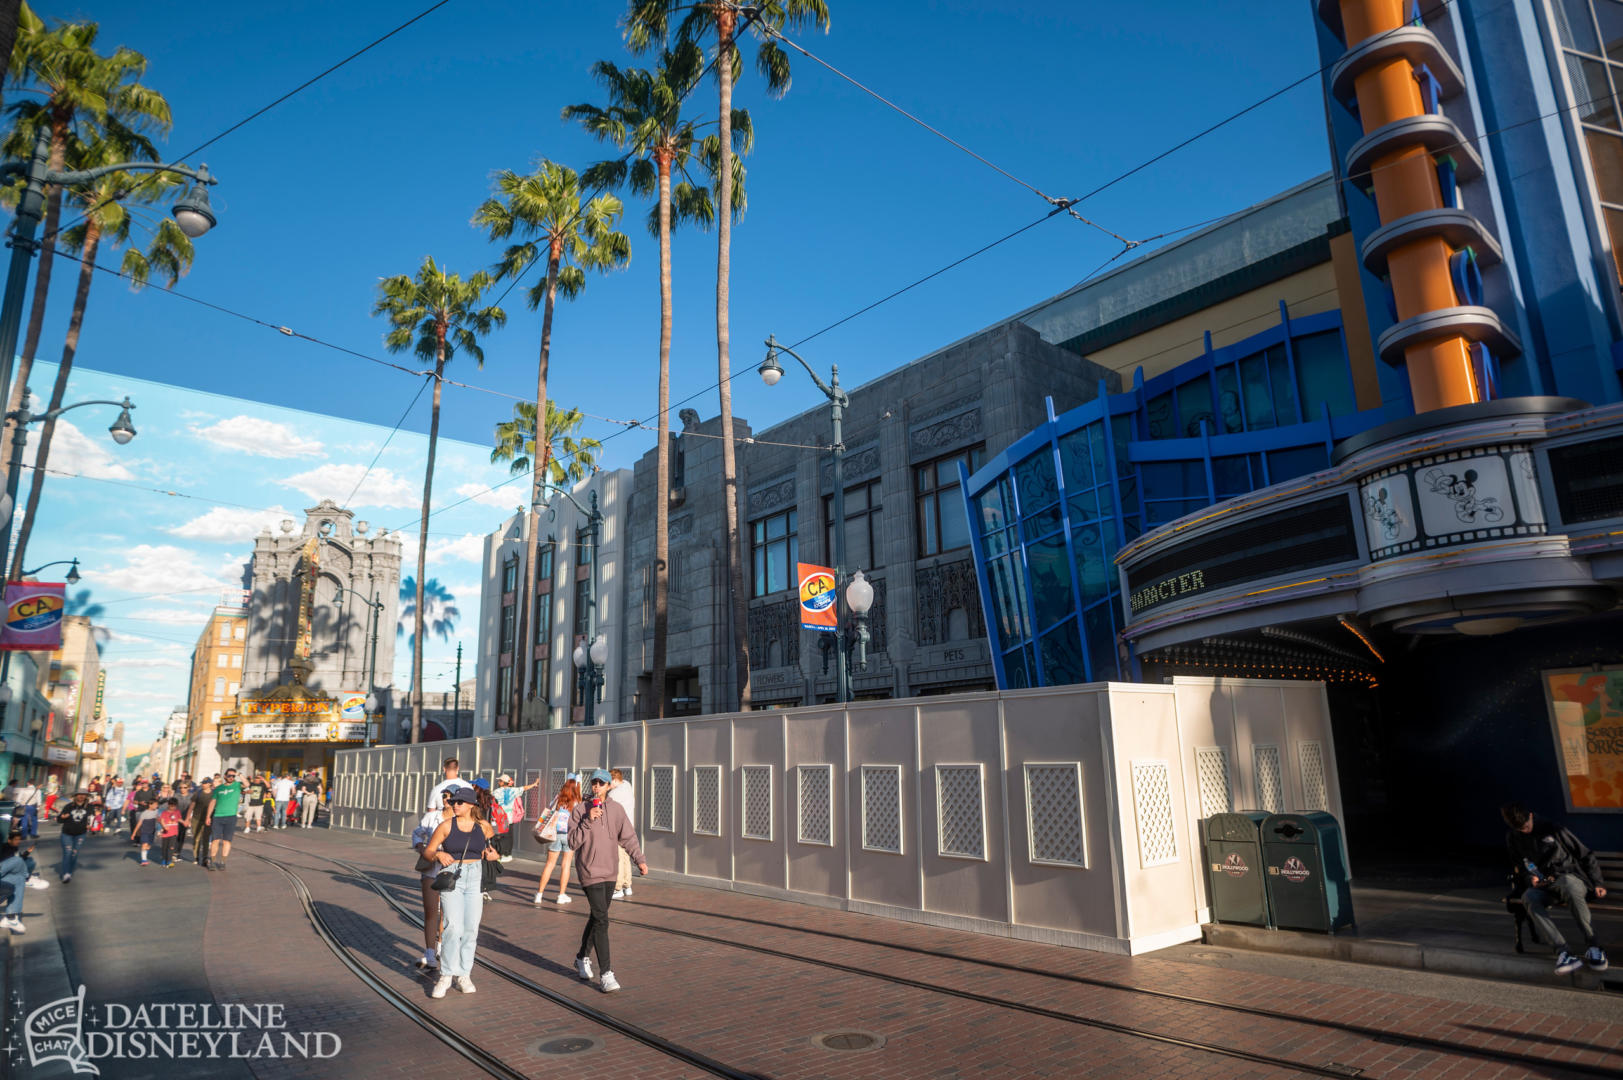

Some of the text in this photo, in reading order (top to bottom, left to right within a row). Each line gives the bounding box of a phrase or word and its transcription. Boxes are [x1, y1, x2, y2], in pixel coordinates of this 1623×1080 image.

[807, 578, 829, 596] CA
[17, 599, 51, 617] CA
[944, 649, 965, 662] PETS
[247, 702, 330, 714] HYPERION
